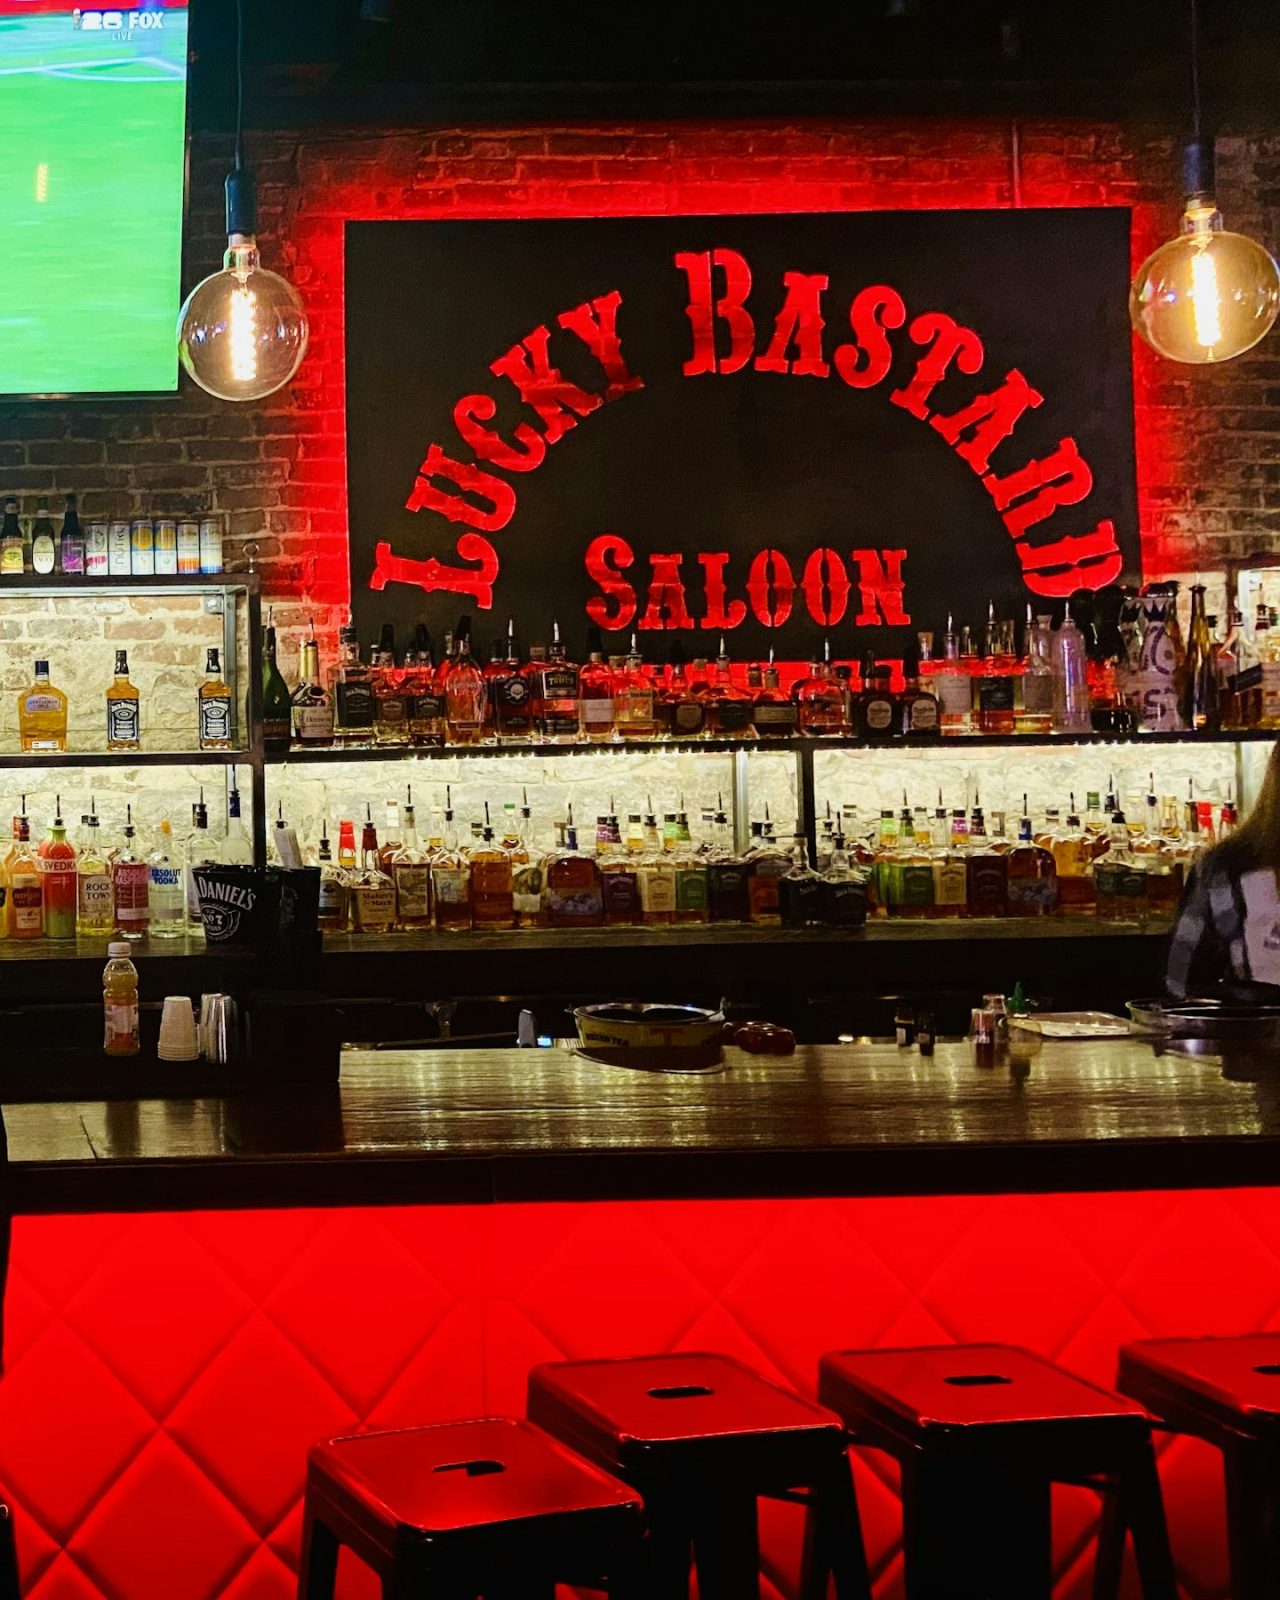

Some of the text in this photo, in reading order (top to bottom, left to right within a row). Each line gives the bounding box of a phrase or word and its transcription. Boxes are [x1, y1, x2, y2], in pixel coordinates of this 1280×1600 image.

[128, 11, 164, 30] FOX
[112, 32, 133, 41] LIVE
[370, 248, 1124, 610] LUCKY BASTARD
[585, 535, 911, 631] SALOON
[154, 876, 179, 885] VODKA
[198, 876, 257, 911] DANIEL'S
